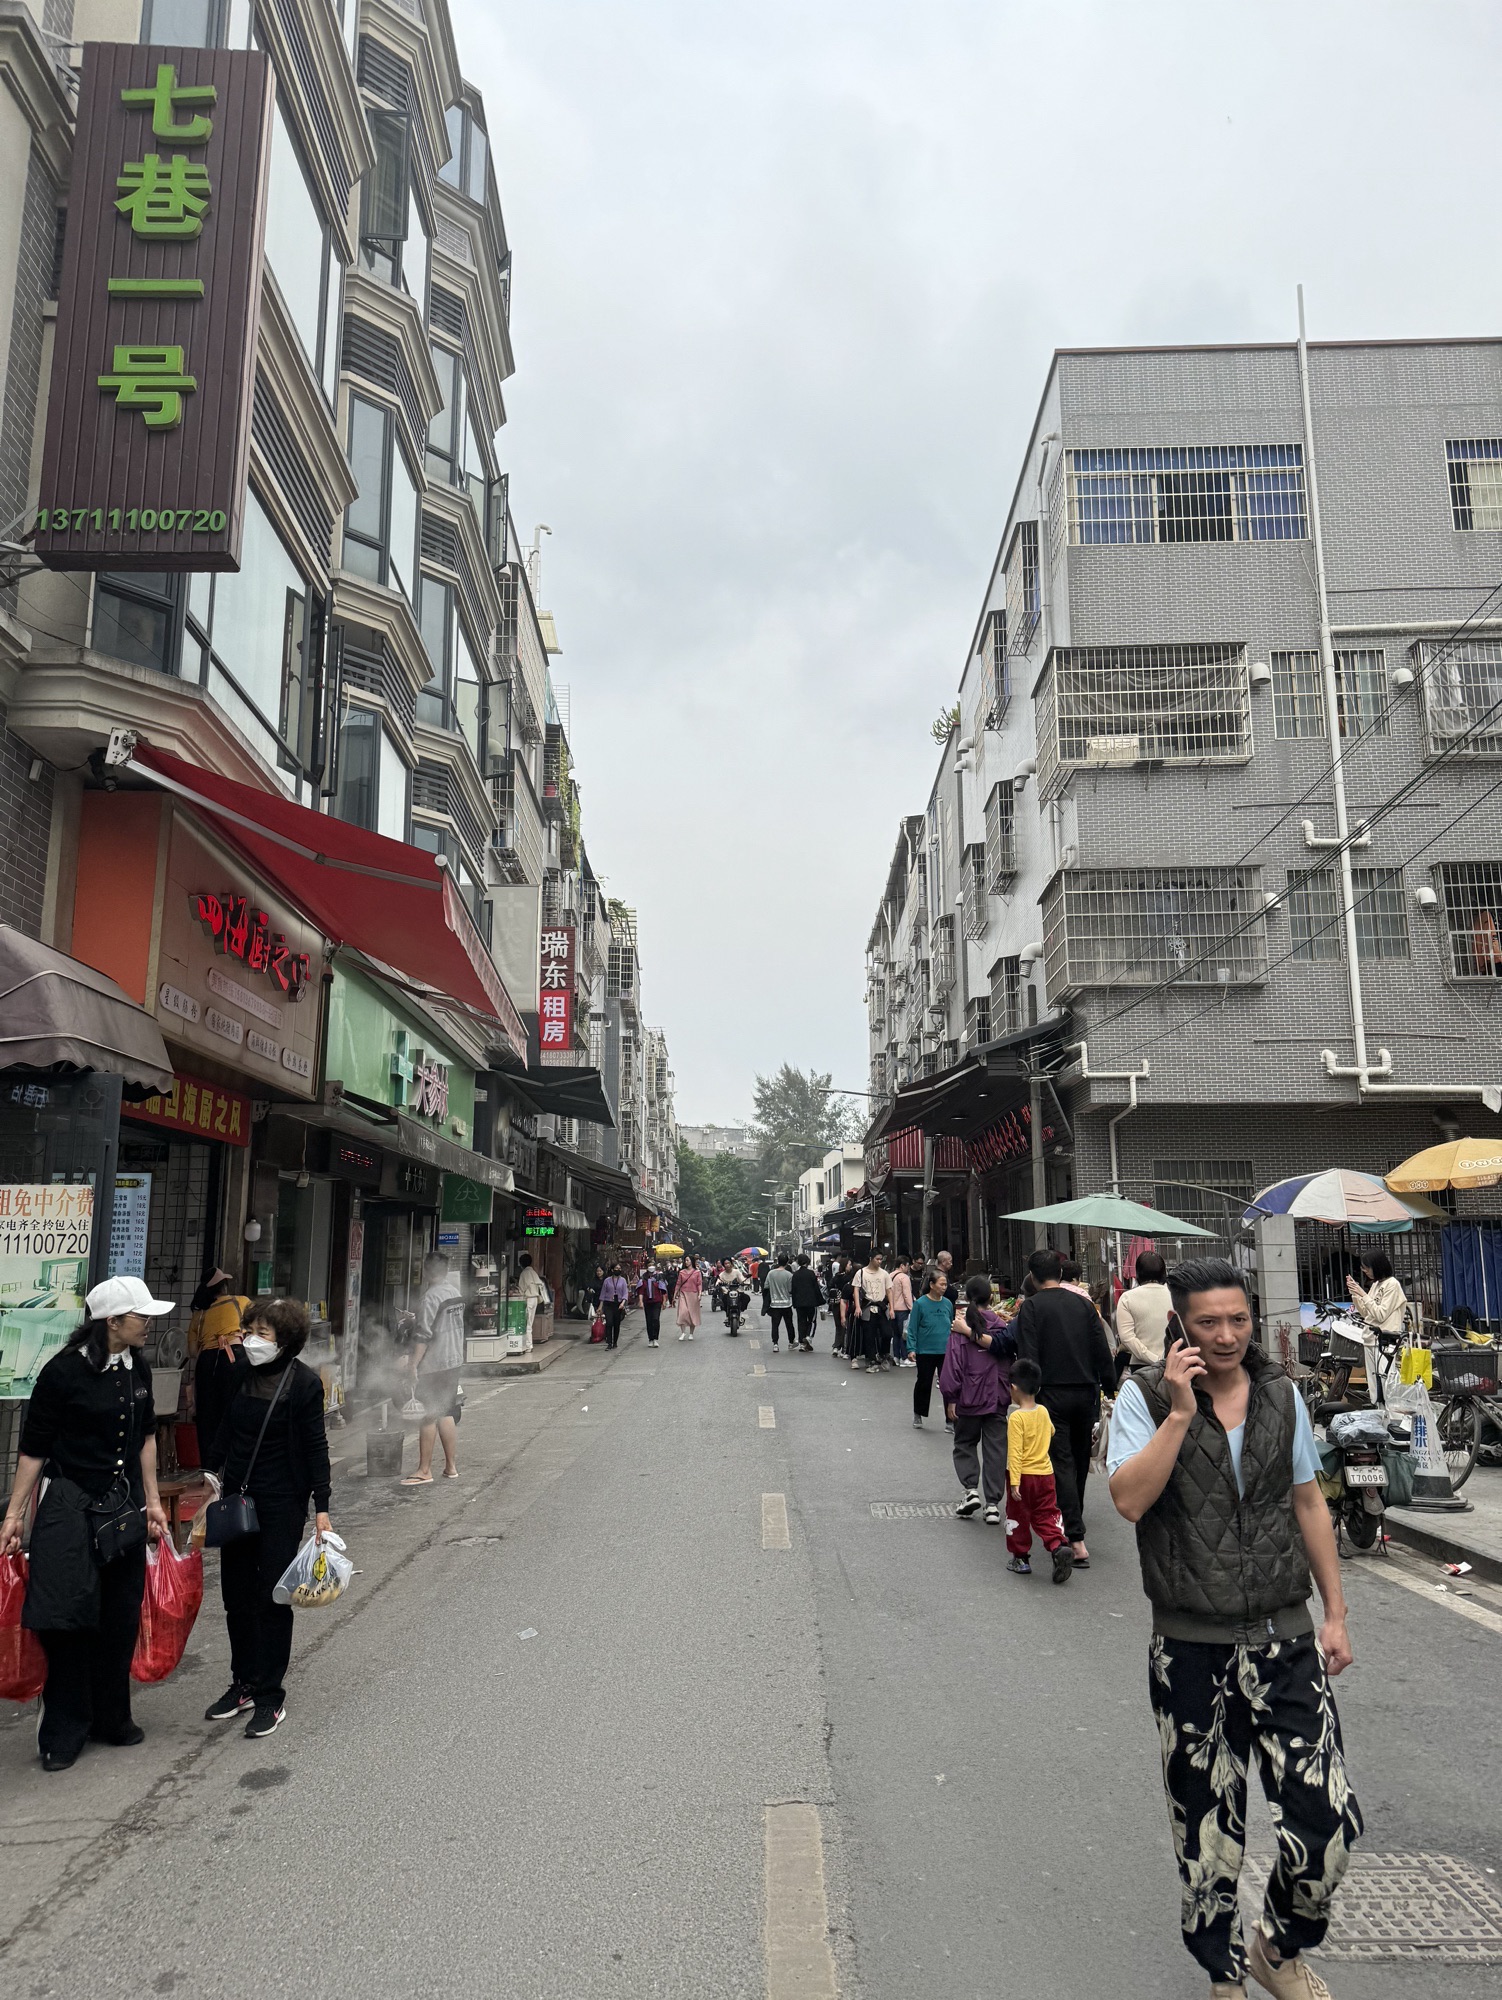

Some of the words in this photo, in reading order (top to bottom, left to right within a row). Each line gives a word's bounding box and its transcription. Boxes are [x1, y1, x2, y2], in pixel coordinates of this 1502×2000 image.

[97, 63, 217, 430] 七巷一号
[36, 508, 227, 534] 13711100720
[414, 1050, 450, 1125] 大参林
[43, 1219, 89, 1231] 拎包入住
[0, 1233, 89, 1255] 11100720
[1350, 1474, 1384, 1483] T70096
